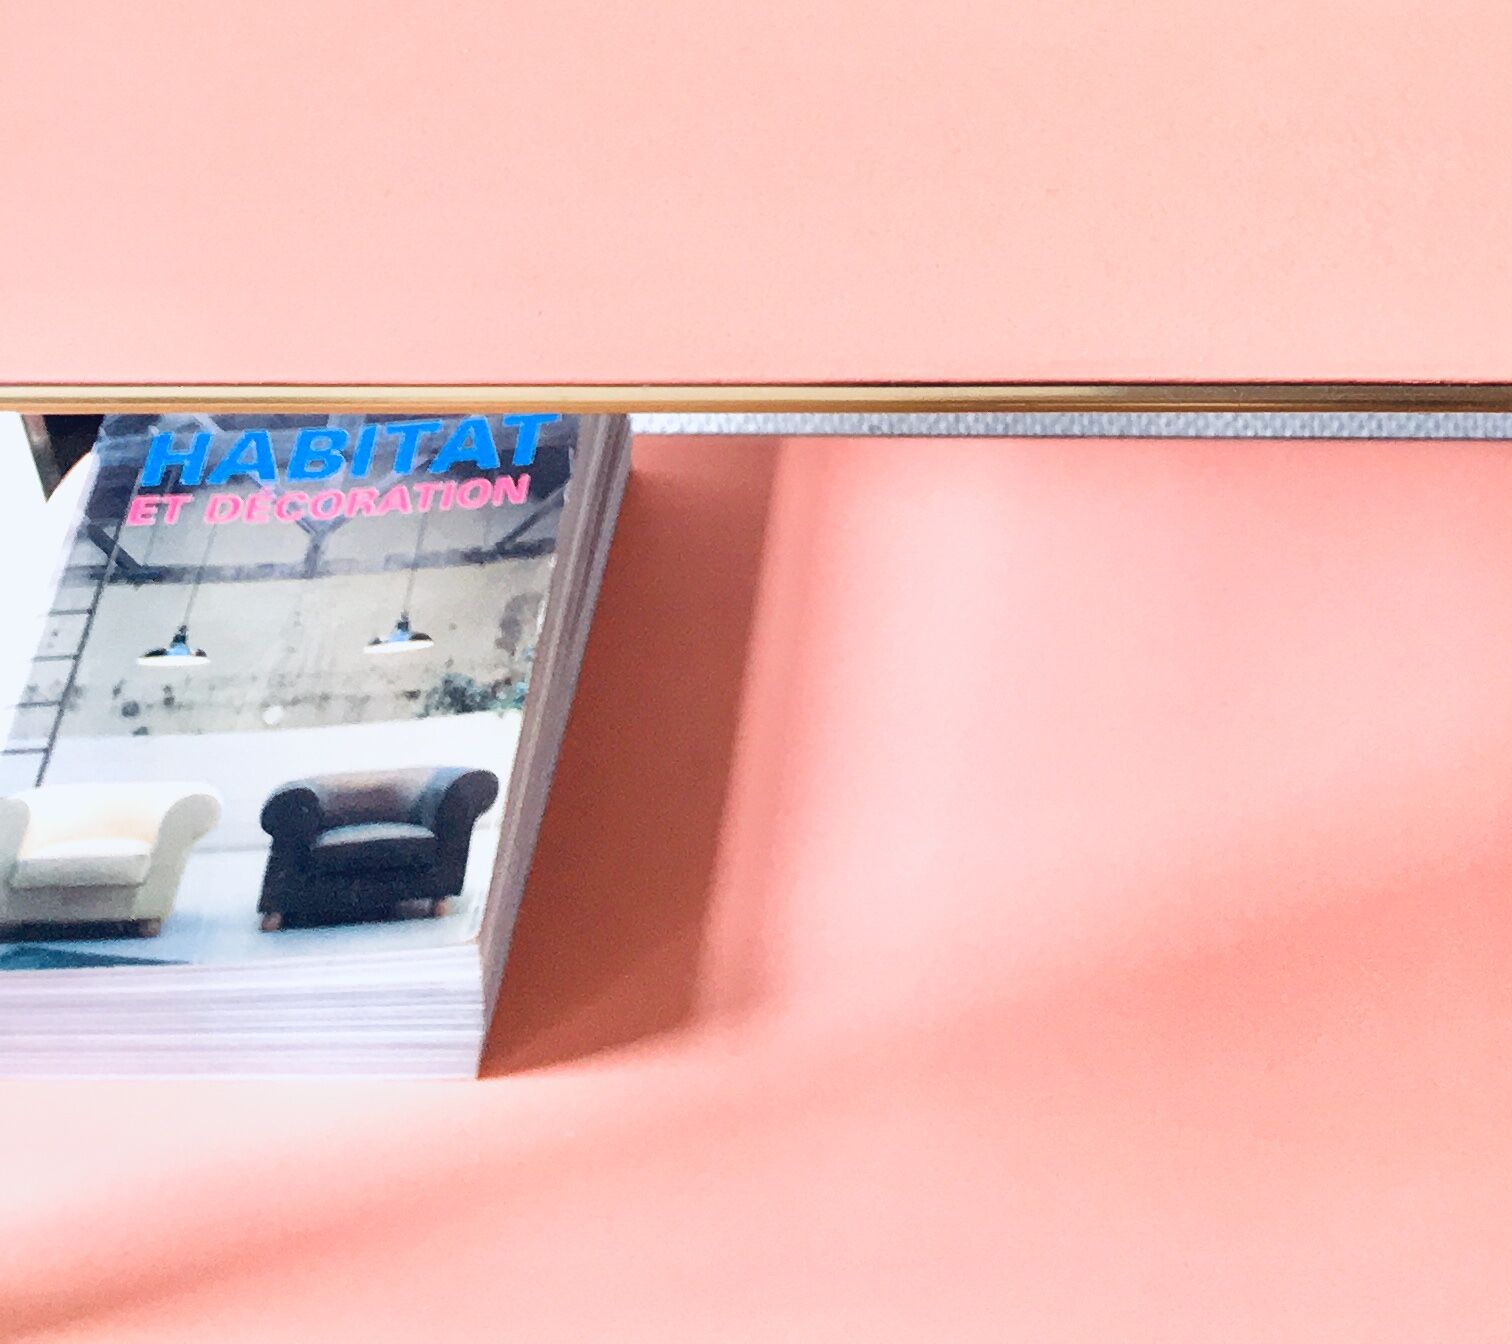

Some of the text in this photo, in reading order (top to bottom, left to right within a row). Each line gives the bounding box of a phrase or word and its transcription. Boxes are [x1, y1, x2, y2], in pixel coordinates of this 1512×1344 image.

[140, 412, 562, 487] HABITAT
[126, 473, 531, 527] ET DÉCORATION
